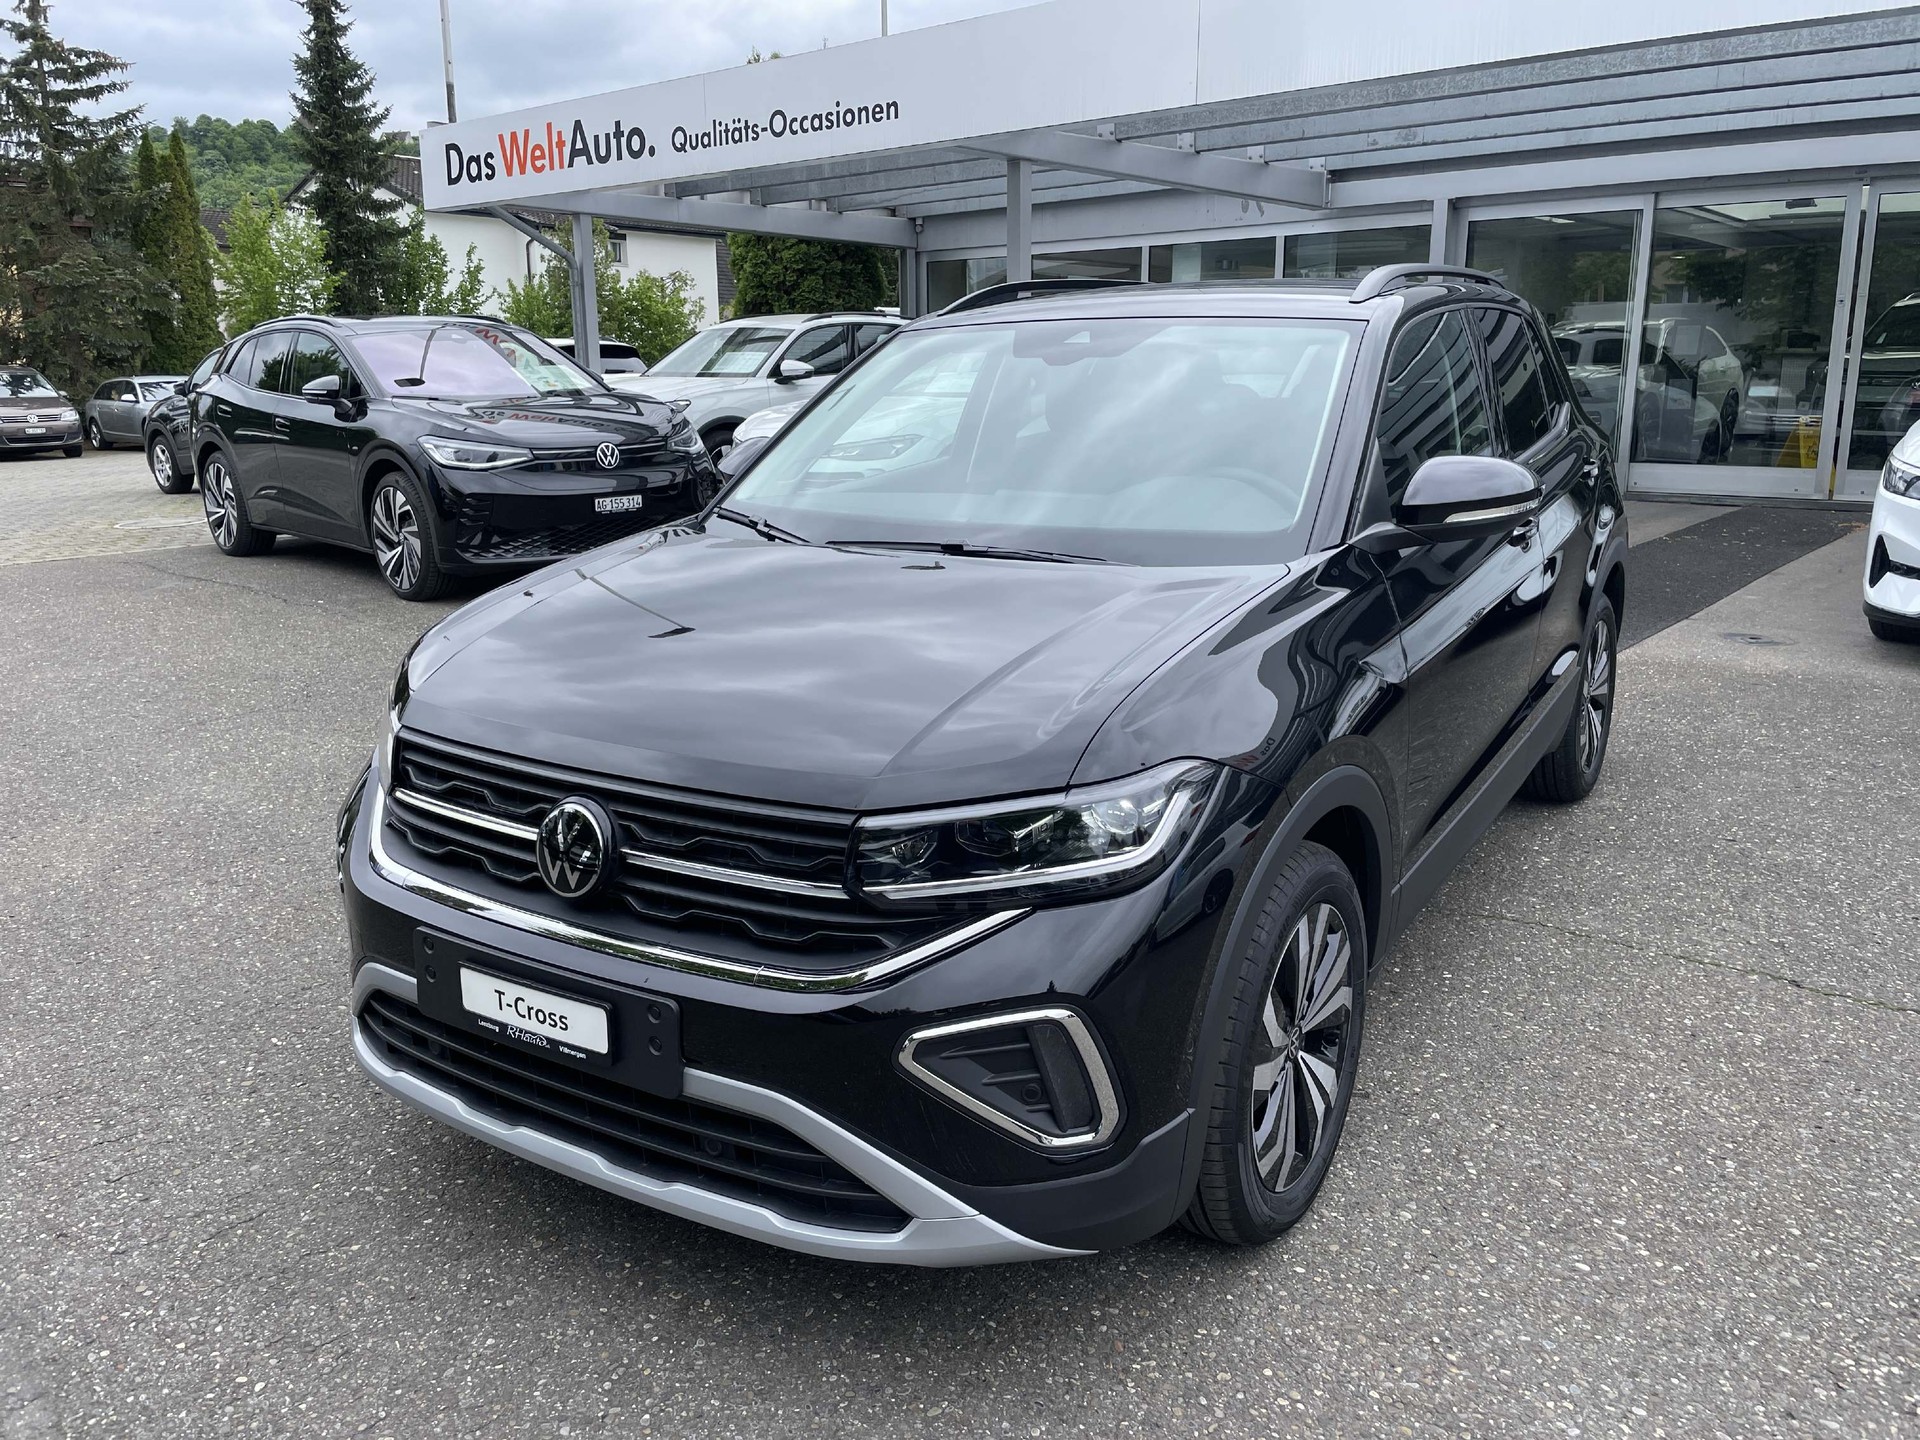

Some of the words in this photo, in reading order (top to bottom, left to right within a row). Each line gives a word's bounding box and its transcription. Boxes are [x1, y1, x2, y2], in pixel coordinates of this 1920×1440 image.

[445, 142, 496, 186] Das
[671, 100, 899, 153] Qualitäts-Occasionen
[494, 989, 569, 1032] T-Cross
